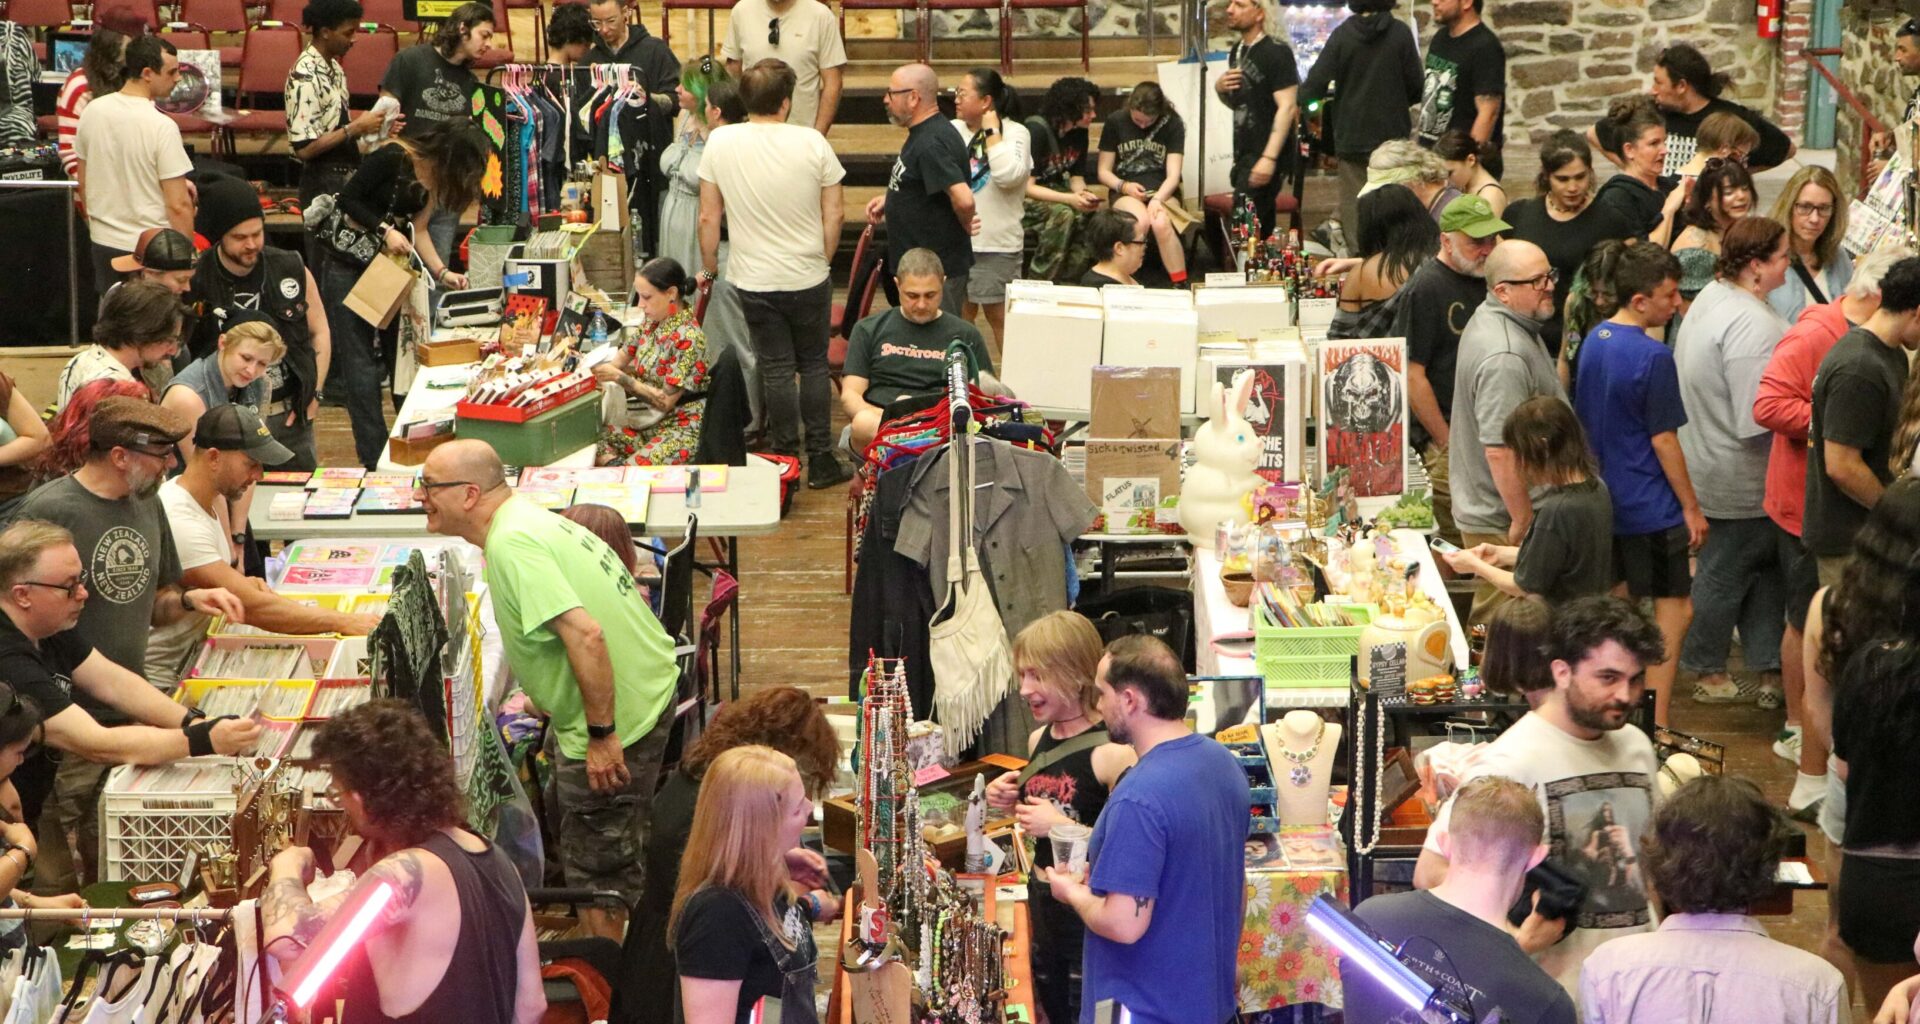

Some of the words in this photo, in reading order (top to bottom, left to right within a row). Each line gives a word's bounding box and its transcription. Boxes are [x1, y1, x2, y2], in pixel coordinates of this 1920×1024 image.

[1105, 480, 1133, 502] FLATUS
[96, 535, 113, 562] NEW
[112, 529, 150, 558] ZEALAND
[96, 571, 114, 594] NEW
[115, 568, 150, 600] ZEALAND
